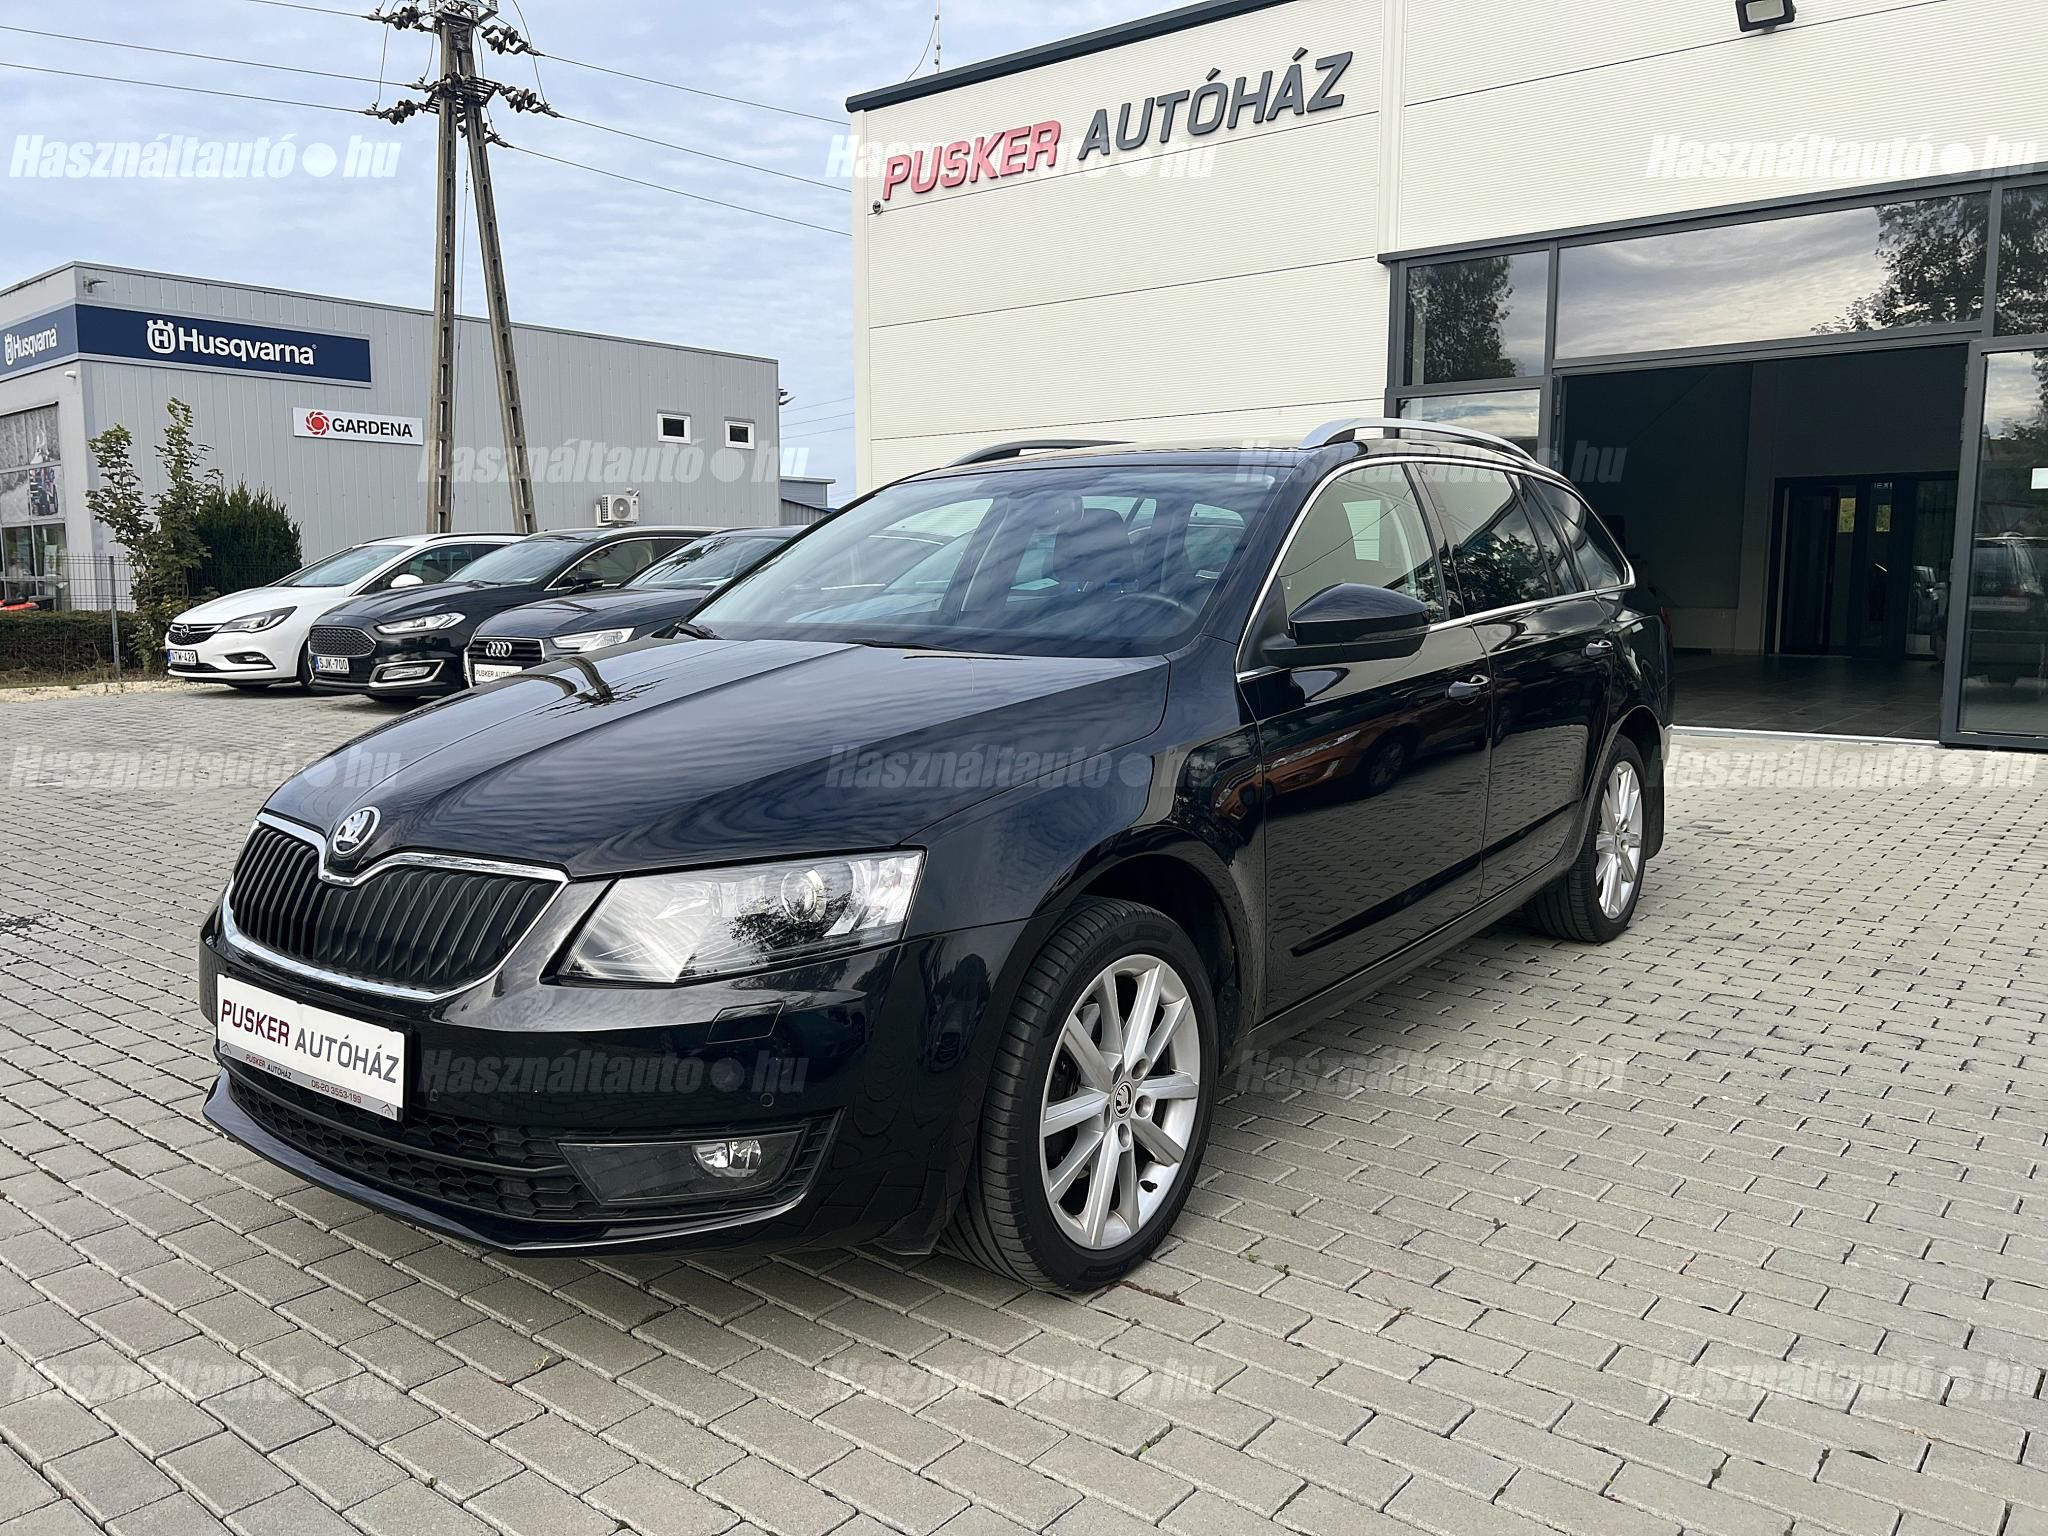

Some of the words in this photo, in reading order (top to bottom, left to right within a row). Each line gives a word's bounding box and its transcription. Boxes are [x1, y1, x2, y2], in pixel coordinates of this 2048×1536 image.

[883, 120, 1062, 200] PUSKER
[1078, 46, 1354, 160] AUTÓHÁZ
[13, 328, 57, 359] Husqvarna
[178, 327, 315, 366] Husqvarna
[332, 417, 413, 438] GARDENA
[319, 657, 348, 670] SJK-700
[221, 999, 290, 1047] PUSKER
[294, 1028, 399, 1083] AUTÓHÁZ
[246, 1054, 266, 1068] PUSKER
